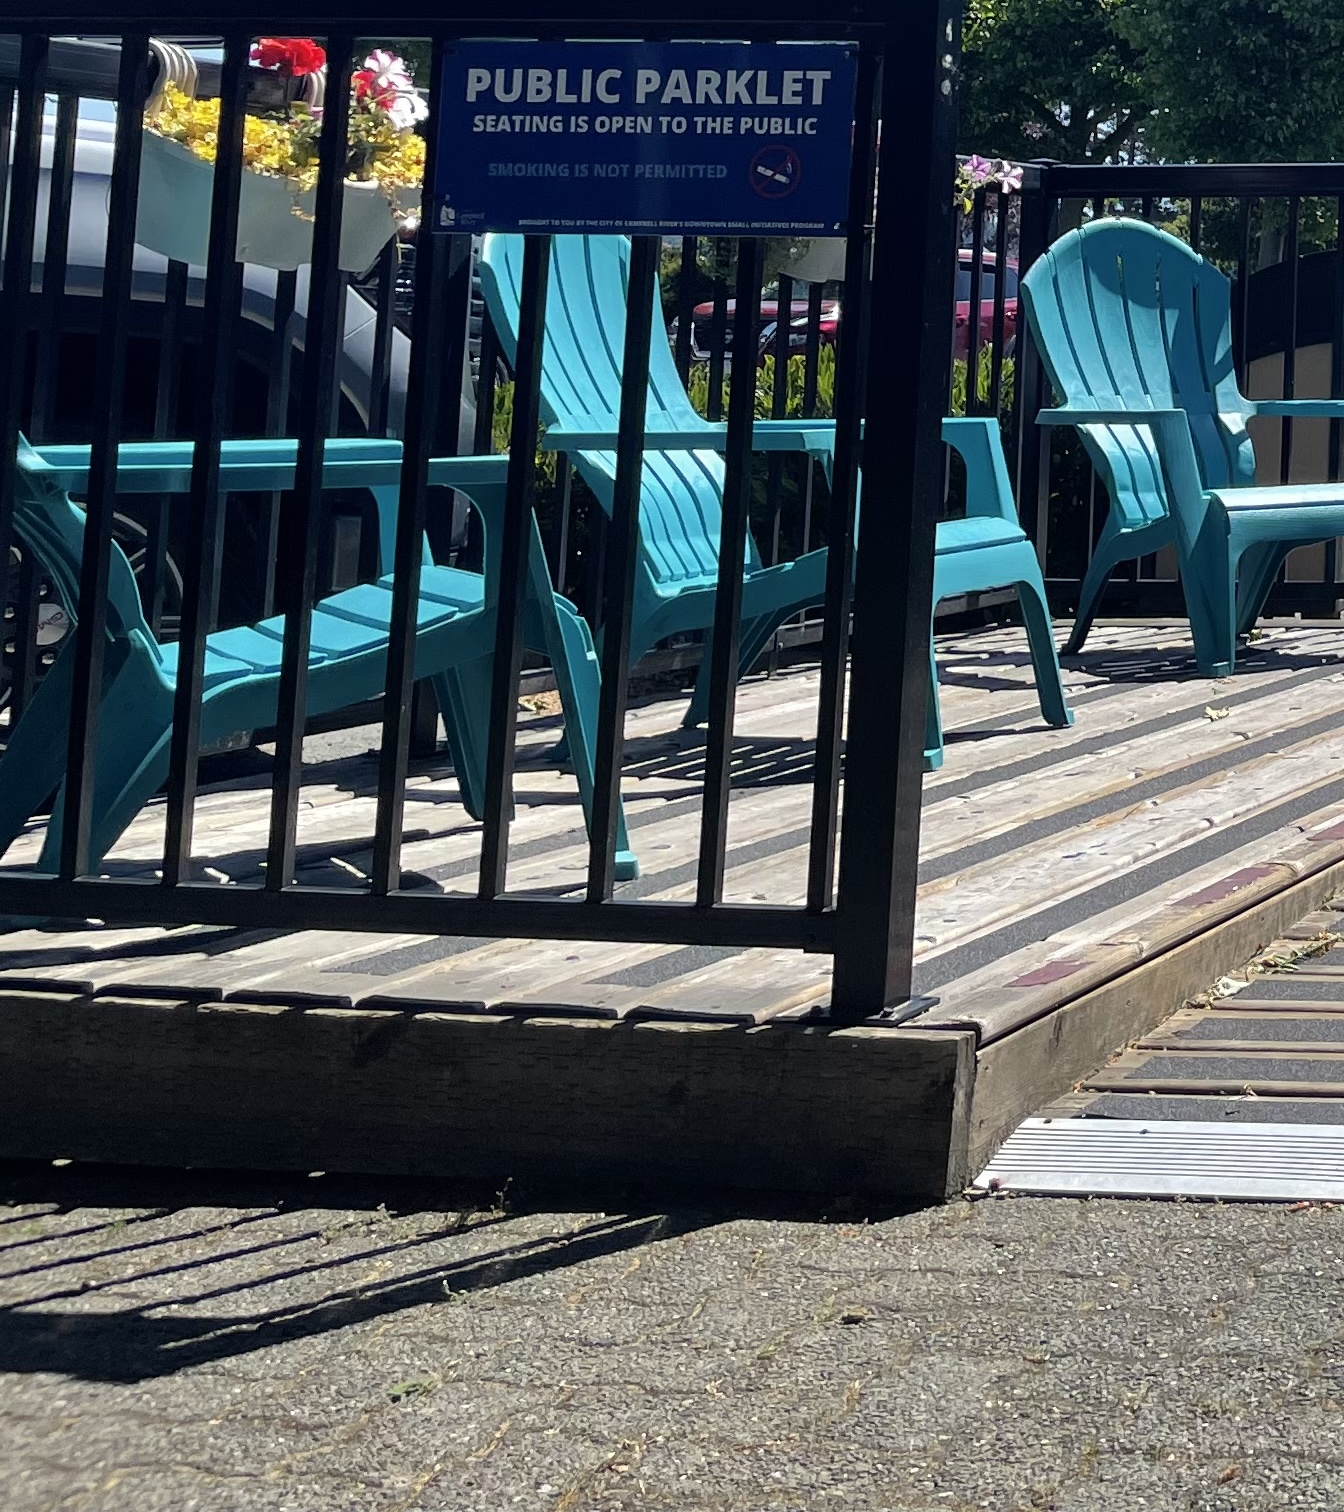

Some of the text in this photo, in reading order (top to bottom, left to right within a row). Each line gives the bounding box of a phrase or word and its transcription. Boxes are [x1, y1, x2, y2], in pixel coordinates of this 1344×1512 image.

[465, 68, 832, 105] PUBLIC PARKLET
[472, 114, 818, 135] SEATING IS OPEN TO THE PUBLIC
[487, 162, 728, 179] SMOKING IS NOT PERMITTED
